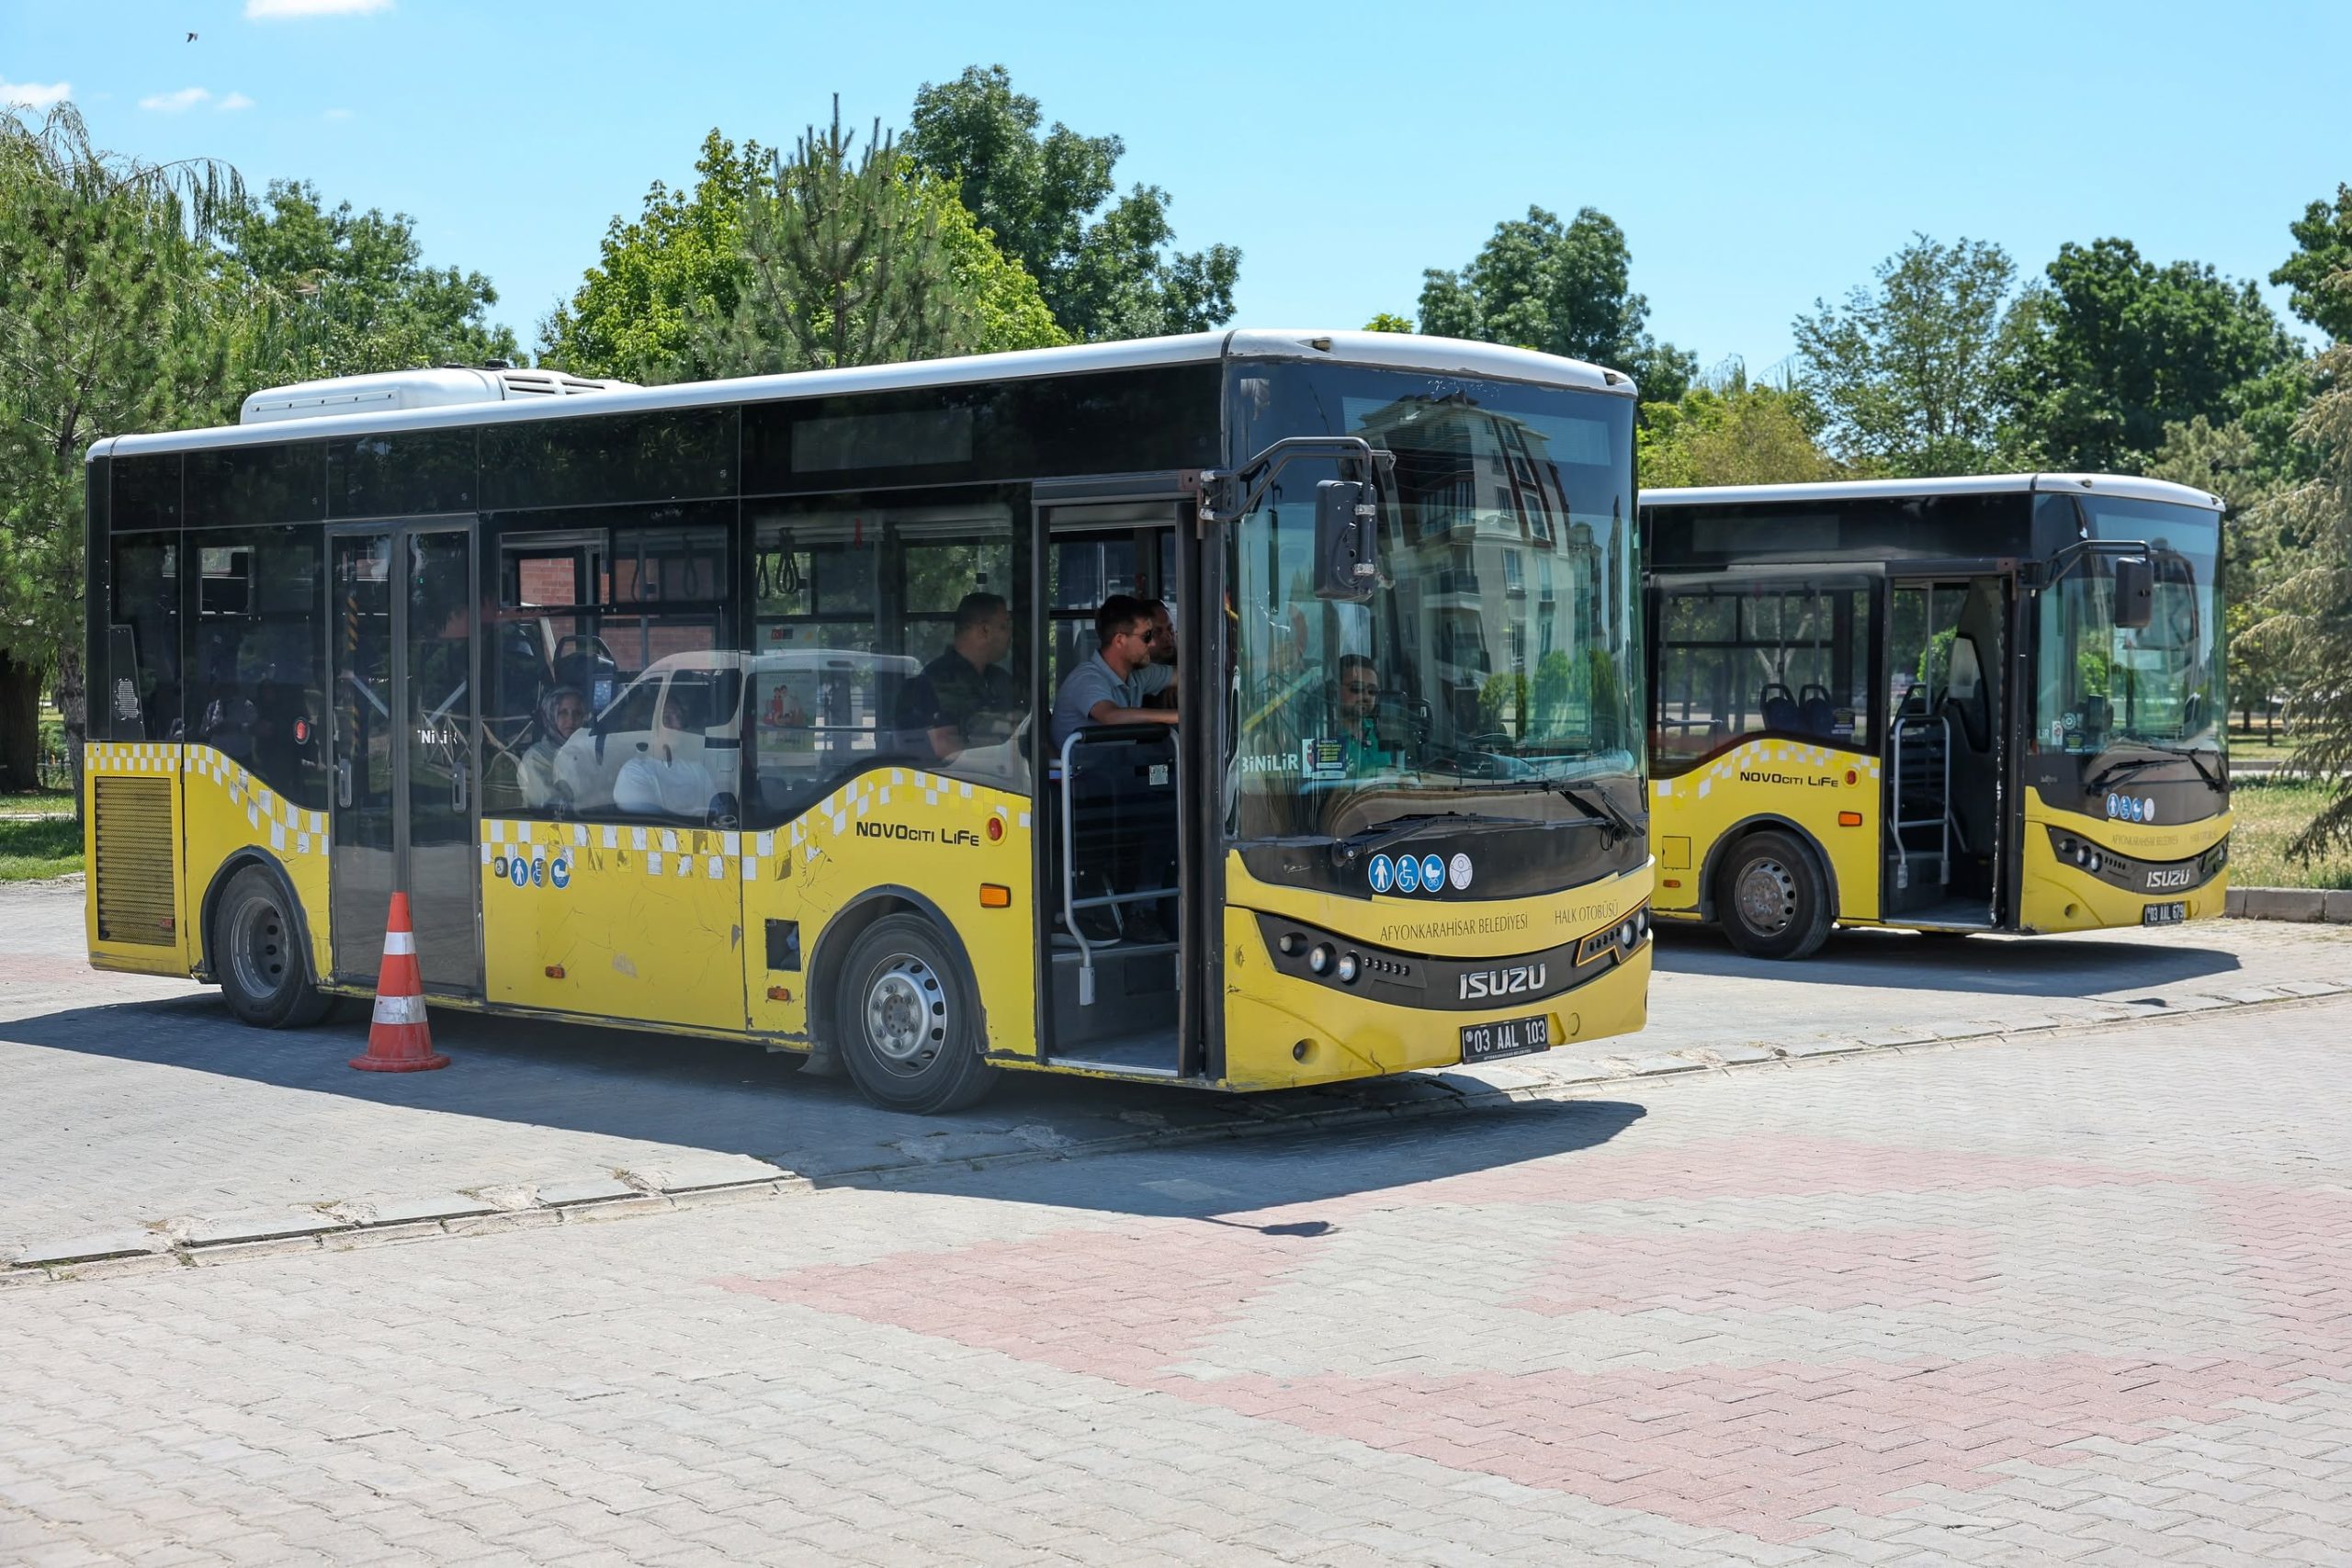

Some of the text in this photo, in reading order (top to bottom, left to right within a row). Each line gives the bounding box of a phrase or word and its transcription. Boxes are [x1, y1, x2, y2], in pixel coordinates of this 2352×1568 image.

[2146, 869, 2190, 887] ISUZU
[1380, 898, 1619, 942] AFYONKARAHİSAR BELEDİYESİ HALK OTOBÜSÜ
[2150, 907, 2158, 921] 03
[2172, 904, 2183, 919] 679
[1459, 963, 1546, 999] ISUZU
[1474, 1020, 1546, 1053] 03 AAL 103
